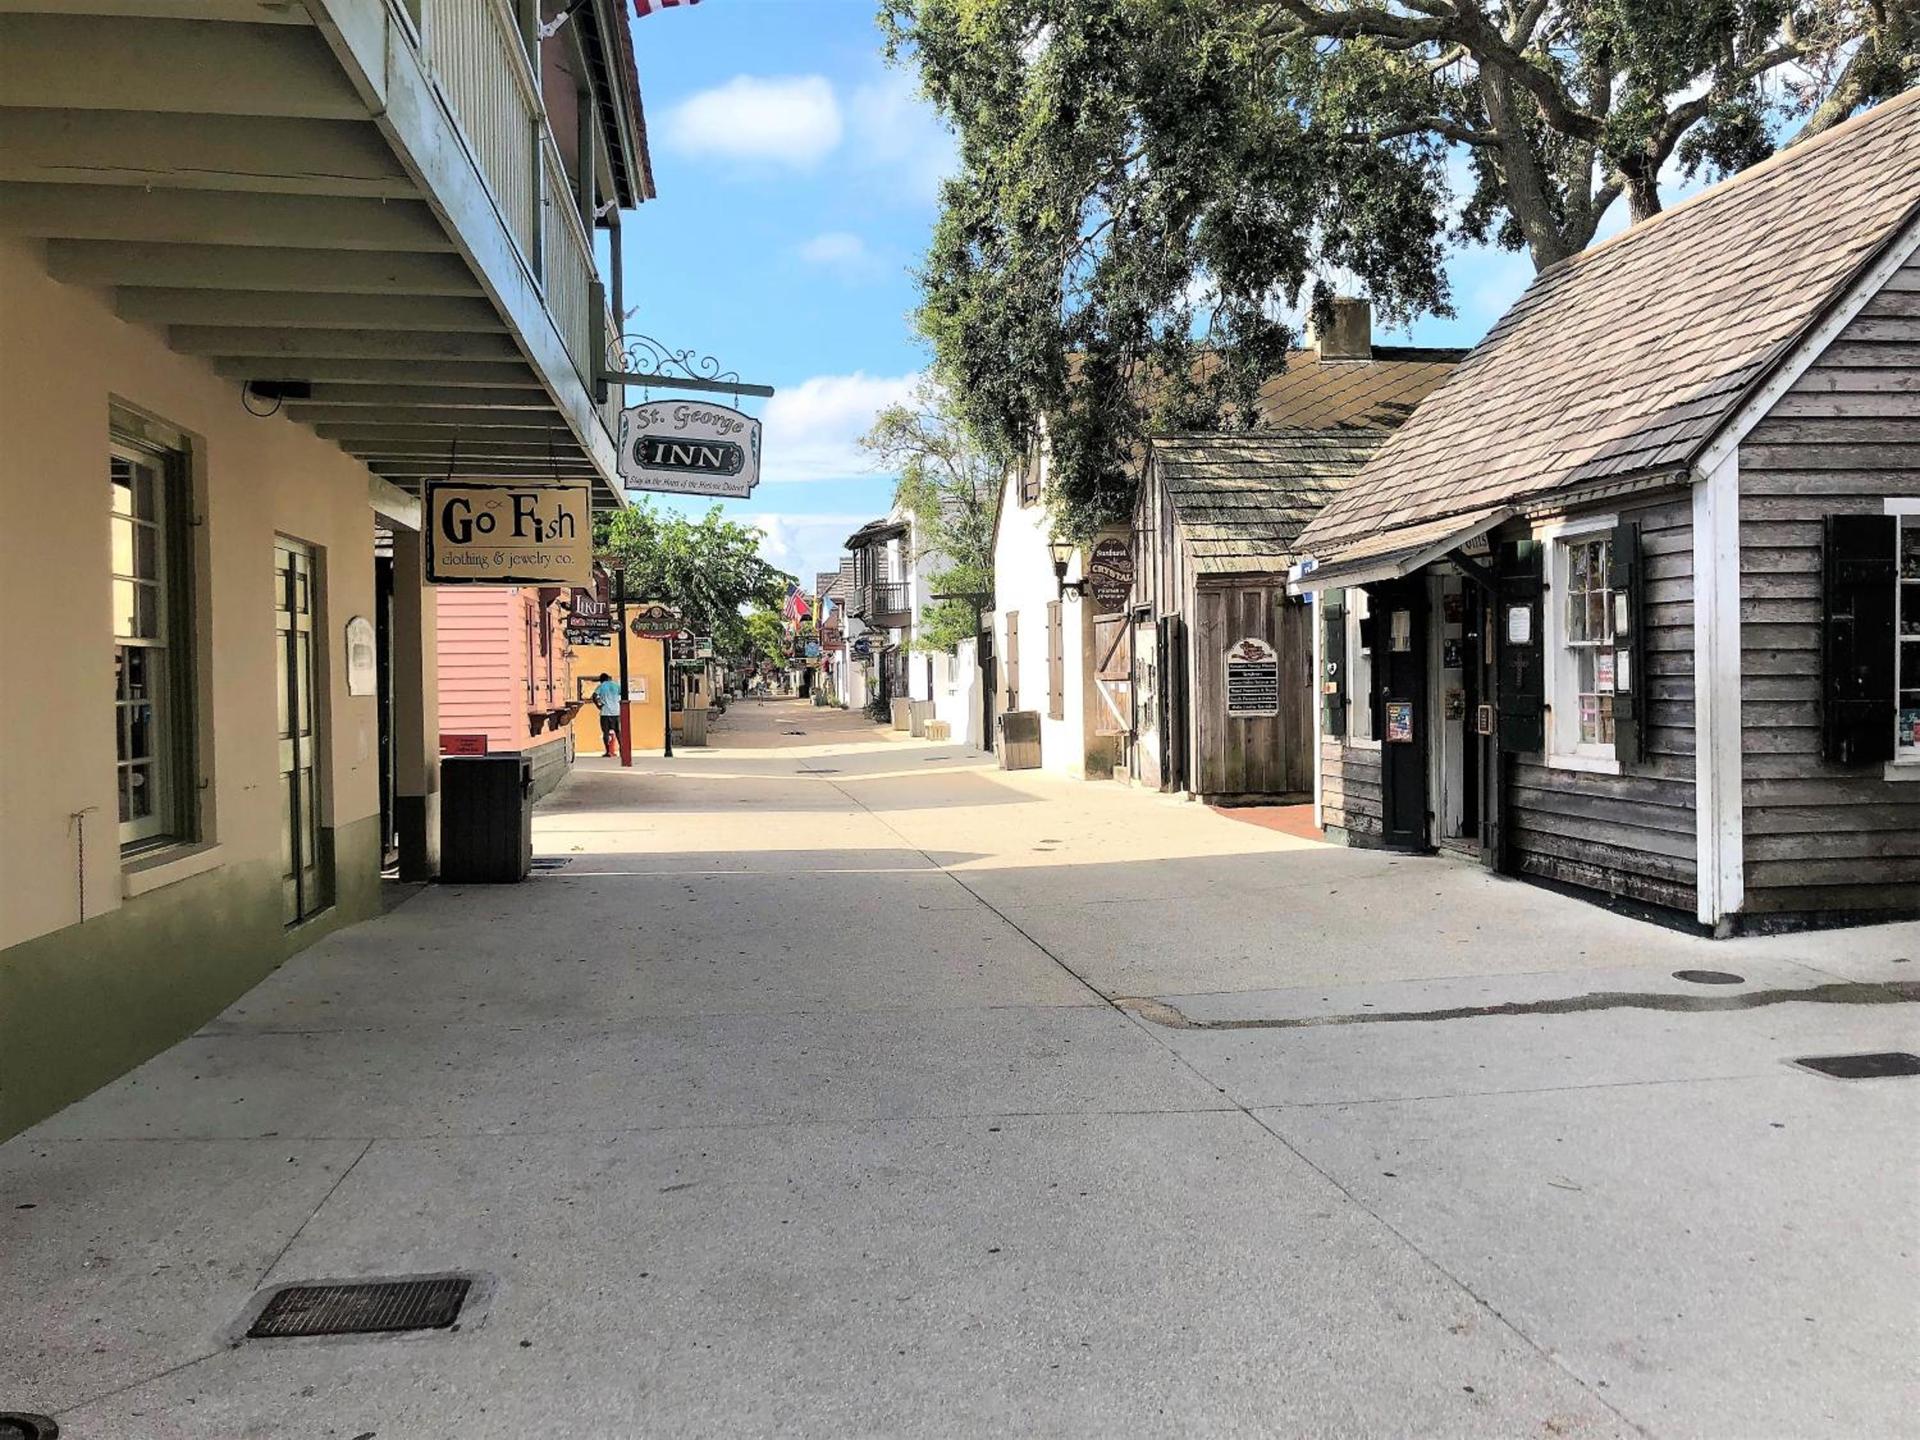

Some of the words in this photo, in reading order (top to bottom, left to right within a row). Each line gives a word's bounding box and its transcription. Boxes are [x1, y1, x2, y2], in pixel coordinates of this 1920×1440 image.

[637, 408, 665, 430] St.
[673, 405, 745, 436] George
[652, 443, 724, 468] INN
[652, 476, 663, 486] the
[680, 478, 687, 488] of
[442, 497, 496, 544] Go
[507, 493, 575, 543] Fish
[442, 551, 489, 569] clothing
[493, 552, 505, 566] &
[508, 551, 551, 569] jewelry
[554, 555, 575, 566] co.
[1092, 564, 1133, 582] CRYSTAL
